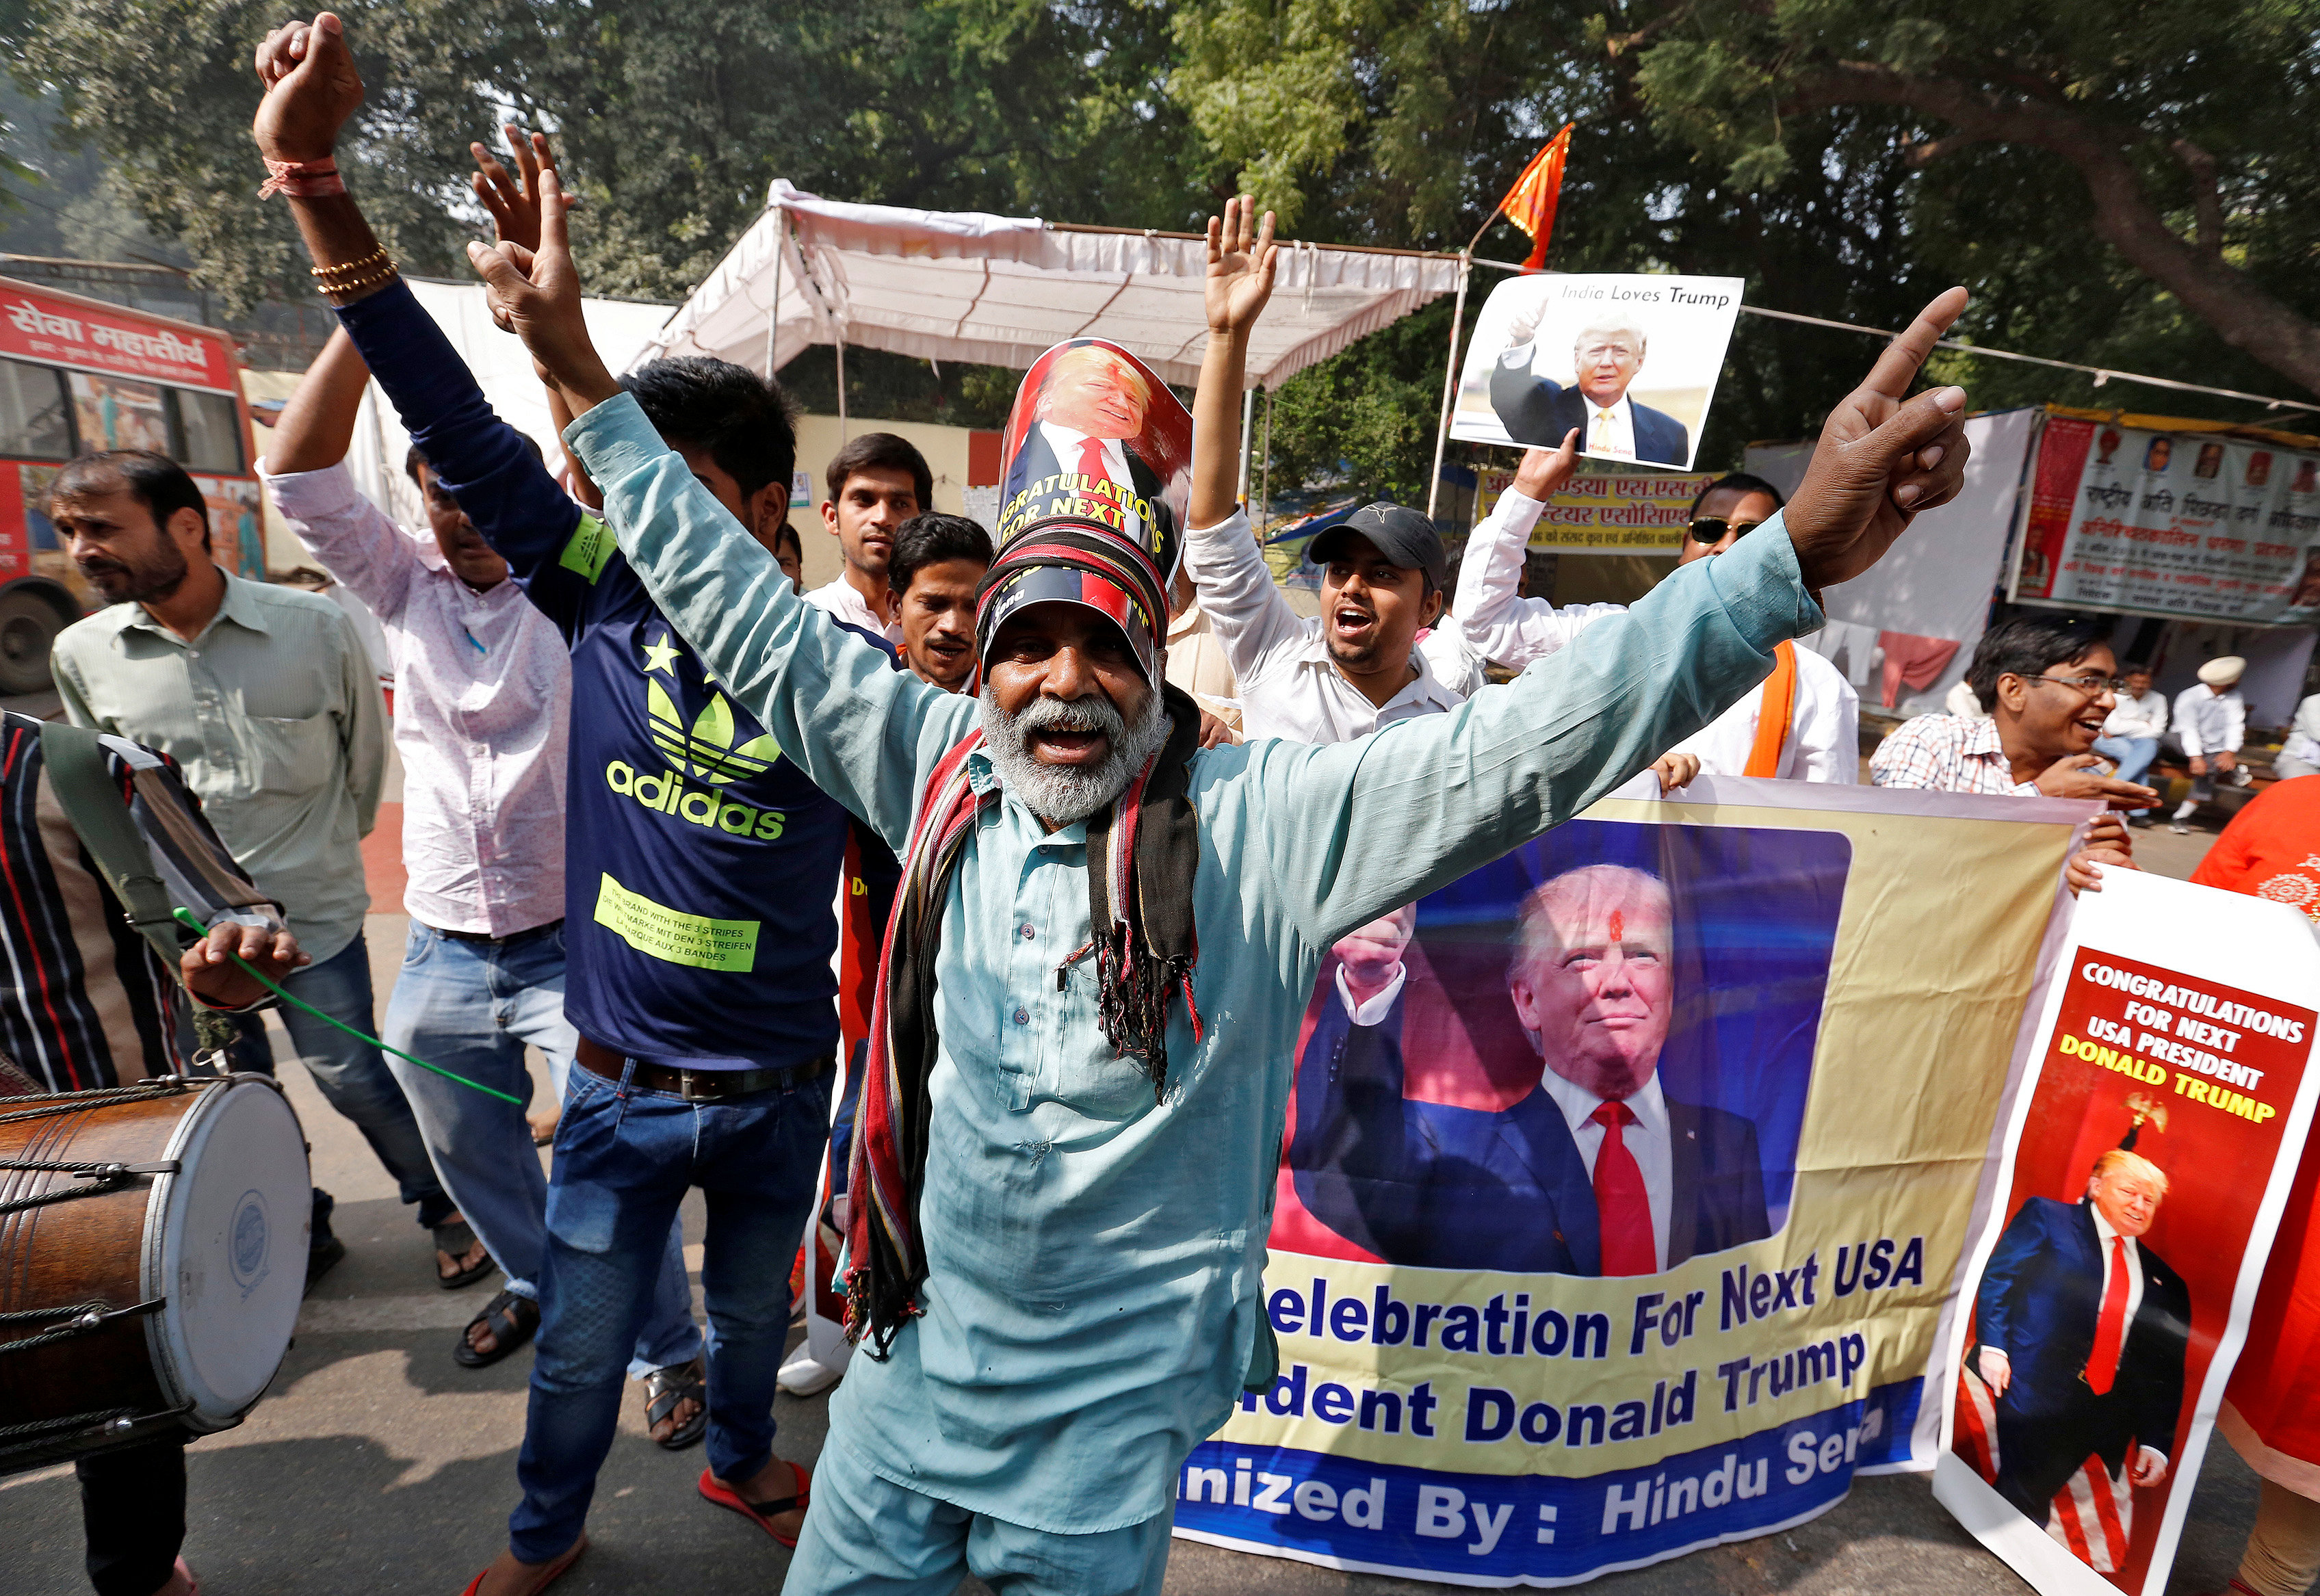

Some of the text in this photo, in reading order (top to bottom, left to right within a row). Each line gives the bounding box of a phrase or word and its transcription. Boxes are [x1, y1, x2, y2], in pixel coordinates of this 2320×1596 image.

[3, 300, 85, 342] सेवा
[1563, 285, 1729, 310] India Loves Trump
[1589, 443, 1611, 452] Hindu
[1002, 497, 1125, 545] FOR NEXT
[605, 760, 786, 840] adidas
[602, 895, 612, 906] DIE
[656, 927, 671, 939] MIT
[673, 933, 694, 944] DEN
[696, 938, 703, 946] 3
[705, 939, 752, 951] STREIFEN
[612, 889, 622, 902] THE
[622, 898, 648, 915] BRAND
[650, 911, 670, 926] WITH
[673, 920, 691, 932] THE
[702, 927, 744, 938] STRIPES
[655, 940, 674, 952] AUX
[684, 948, 727, 962] BANDES
[2081, 962, 2306, 1044] CONGRATULATIONS
[2123, 999, 2242, 1054] FOR NEXT
[2059, 1033, 2276, 1124] DONALD TRUMP
[2086, 1015, 2265, 1091] USA PRESIDENT
[1263, 1236, 1924, 1359] elebration For Next USA
[1465, 1370, 1697, 1449] Donald
[1718, 1332, 1866, 1413] Trump
[1175, 1456, 1387, 1531] nized
[1415, 1483, 1515, 1556] By
[1600, 1454, 1769, 1535] Hindu
